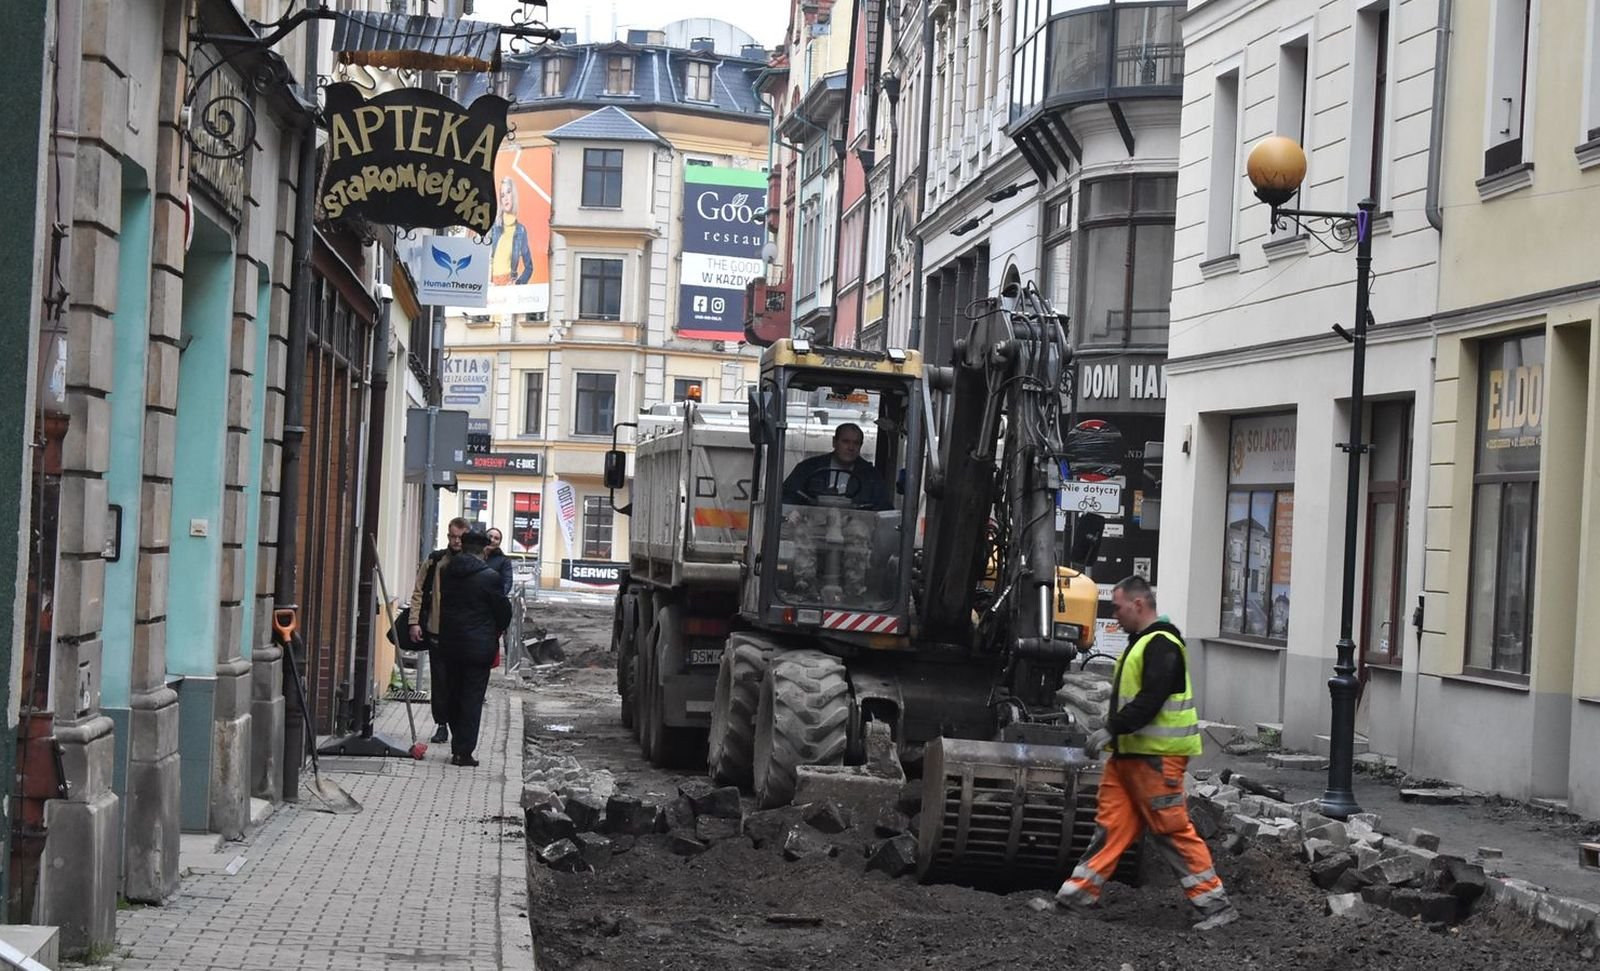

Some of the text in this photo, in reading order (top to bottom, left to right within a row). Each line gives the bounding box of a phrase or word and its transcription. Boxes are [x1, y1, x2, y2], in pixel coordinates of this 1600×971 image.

[332, 105, 496, 172] APTEKA
[707, 257, 761, 274] THE GOOD
[702, 272, 713, 283] W
[423, 280, 482, 291] HumanTherapy
[444, 359, 478, 373] KTIA
[1083, 364, 1119, 399] DOM
[516, 458, 536, 469] E-BIKE
[1063, 484, 1119, 497] Nie dotyczy
[573, 567, 619, 579] SERWIS
